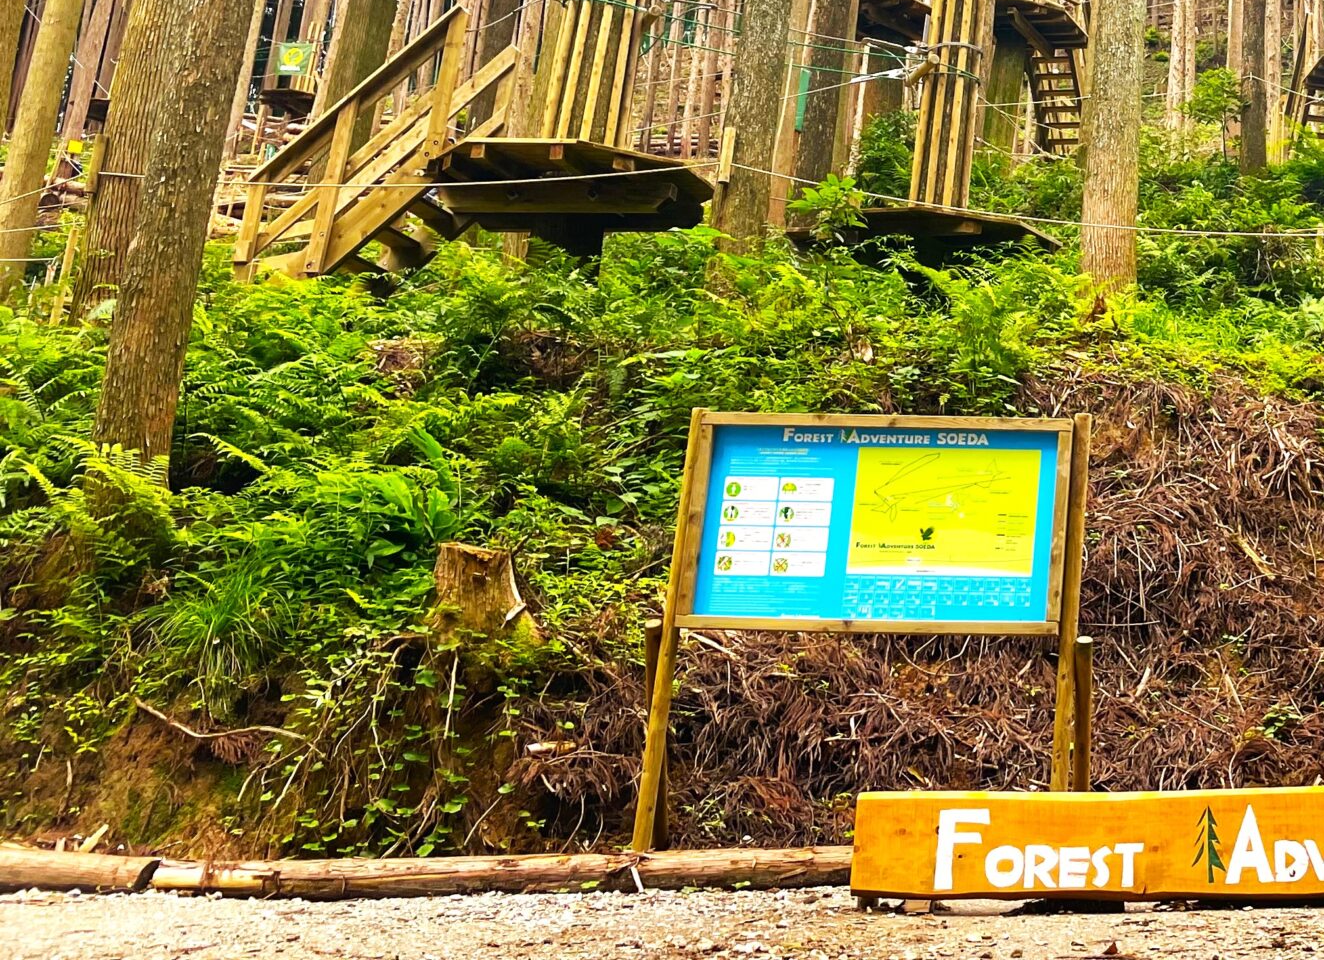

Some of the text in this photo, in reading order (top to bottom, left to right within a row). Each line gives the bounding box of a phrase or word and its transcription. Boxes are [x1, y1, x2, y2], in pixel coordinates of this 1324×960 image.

[783, 427, 989, 446] FOREST ADVENTURE SOEDA
[933, 808, 1145, 890] FOREST
